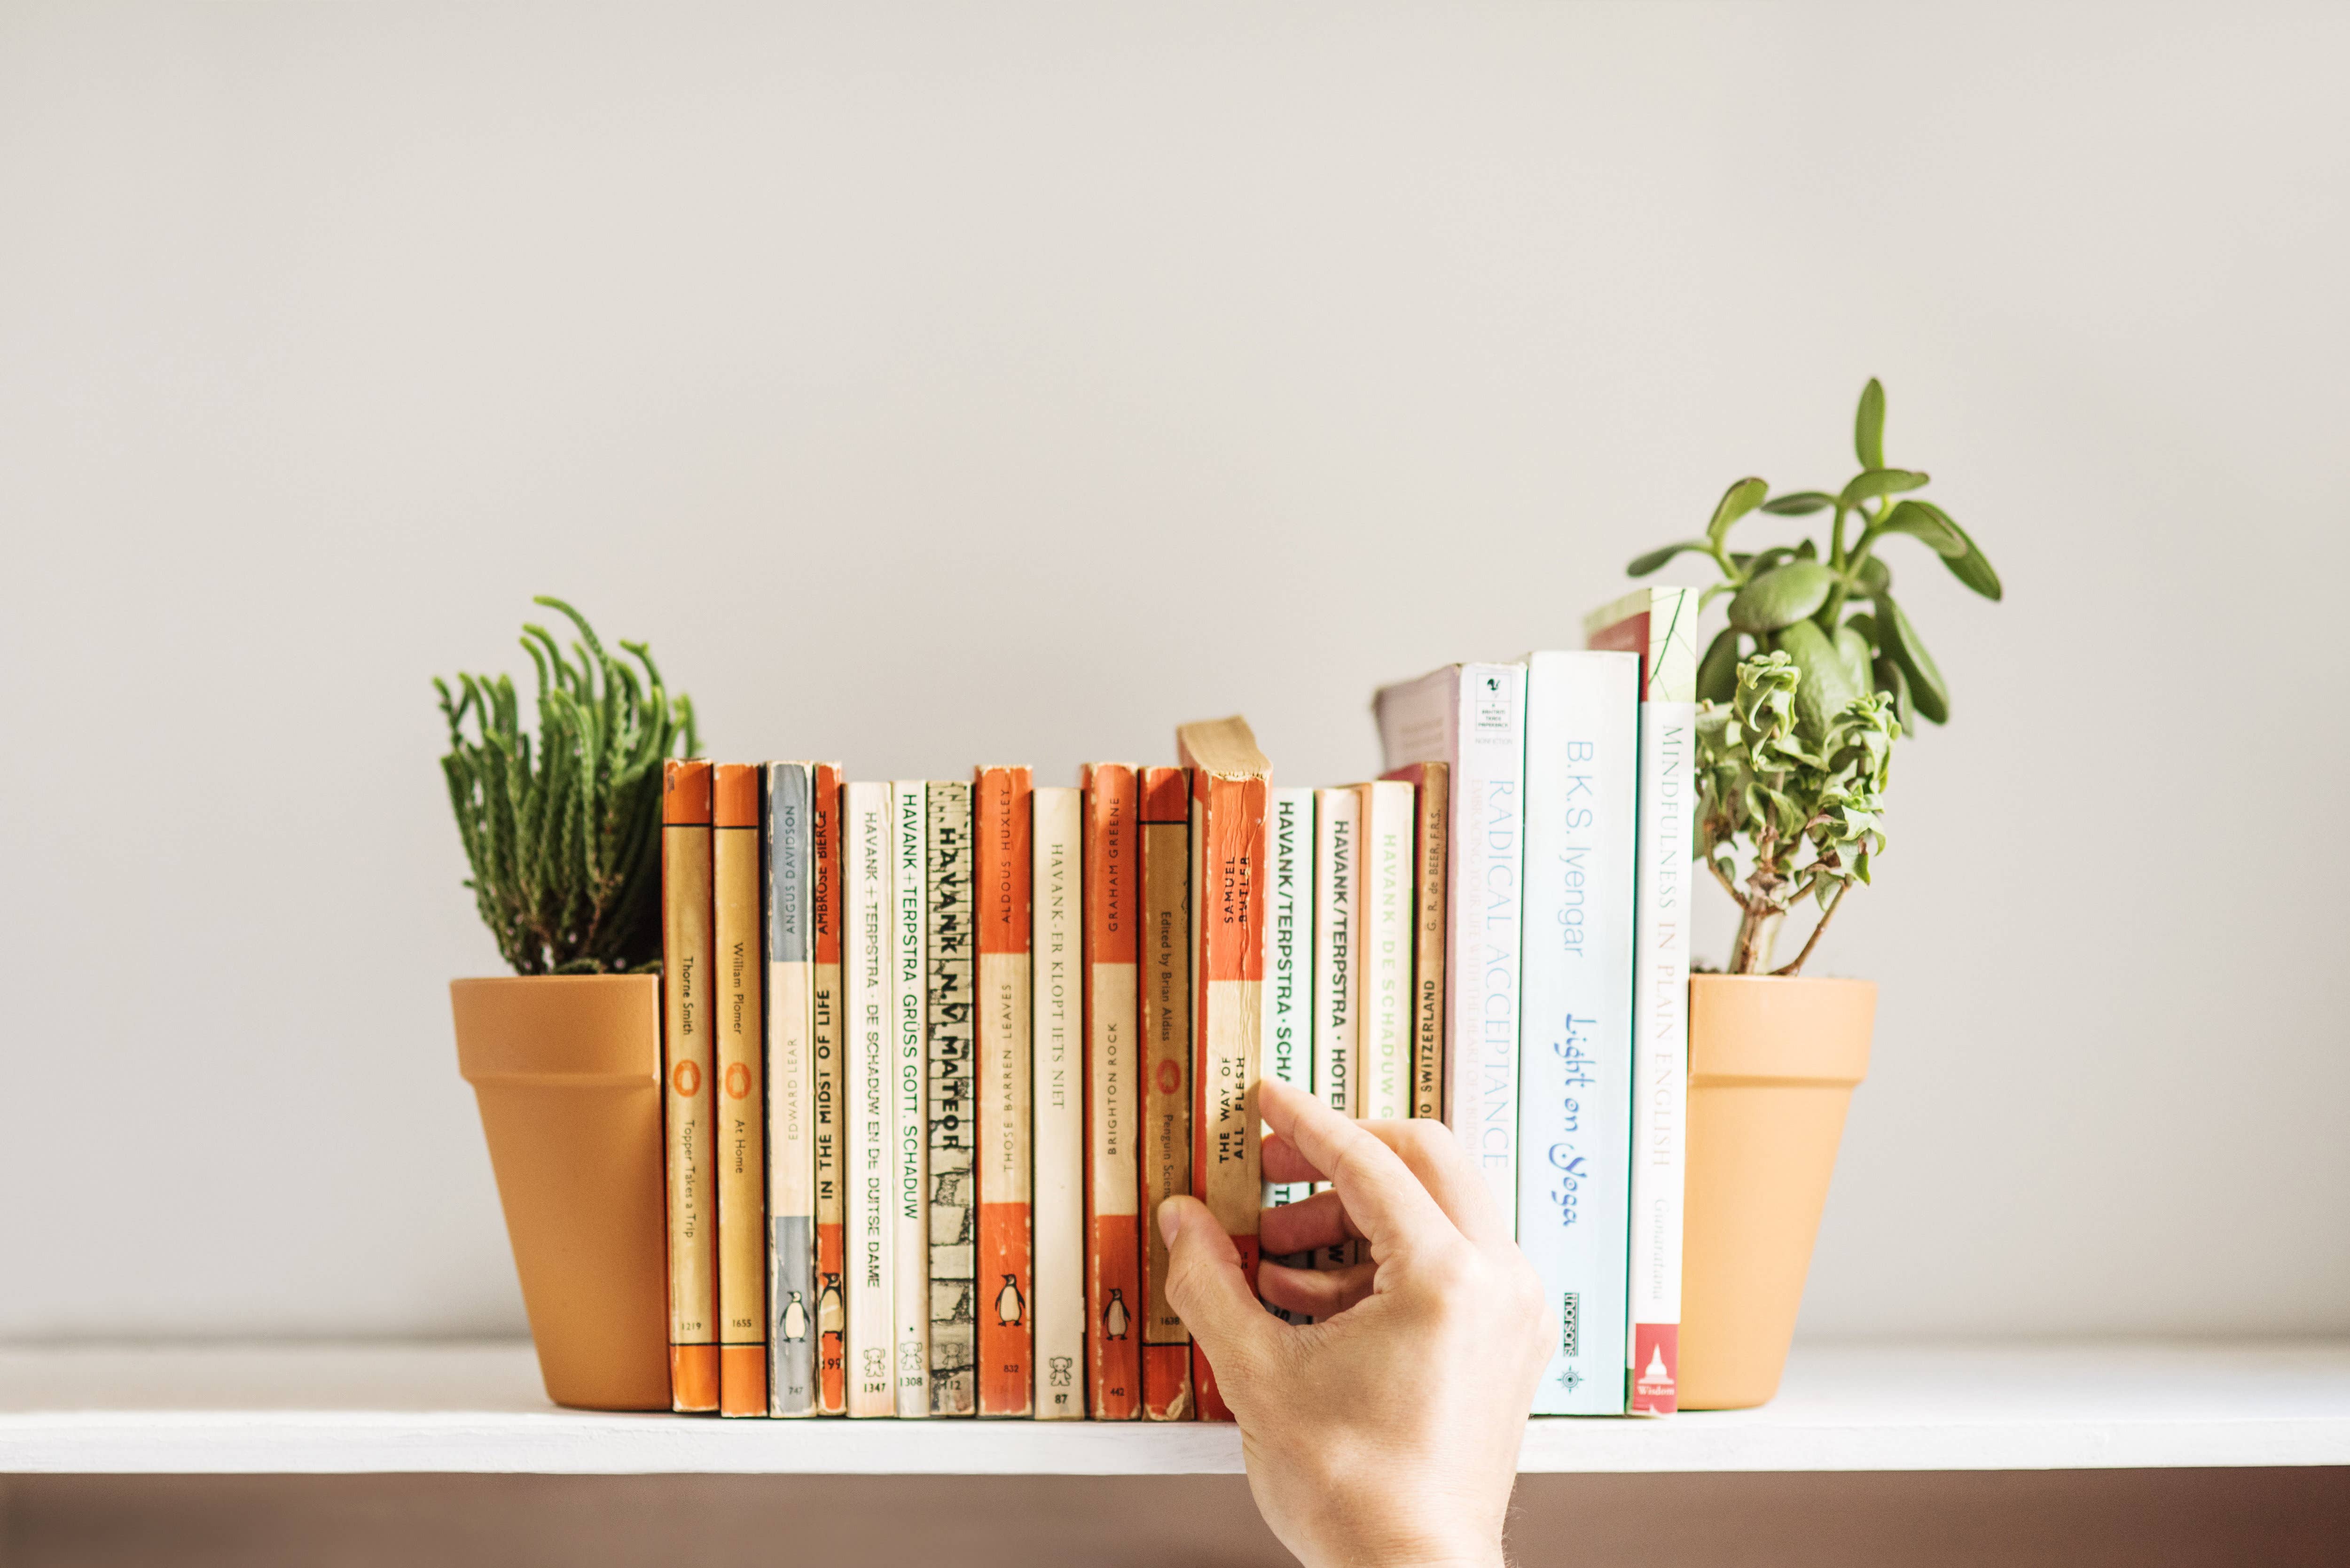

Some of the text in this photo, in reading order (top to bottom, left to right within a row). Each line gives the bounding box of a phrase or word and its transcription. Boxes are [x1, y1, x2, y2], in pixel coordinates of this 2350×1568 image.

[784, 806, 796, 934] ANGUS DAVIDSON
[817, 812, 828, 935] AMBROSE BIERCE
[865, 813, 877, 880] HAVANK
[999, 789, 1011, 924] ALDOUS HUXLEY
[1108, 798, 1119, 932] GRAHAM GREENE
[1383, 835, 1396, 922] HAVANK
[1428, 846, 1441, 874] BEER,
[1558, 741, 1593, 957] B.K.S. Iyengar
[1224, 856, 1235, 923] SAMUEL
[1238, 857, 1247, 923] BUTLER
[1277, 802, 1293, 1014] HAVANK/TERPSTRA
[1427, 901, 1437, 911] R.
[1428, 883, 1438, 894] de
[1469, 868, 1481, 907] YOUR
[866, 903, 878, 988] TERPSTRA
[1332, 821, 1349, 1027] HAVANK/TERPSTRA
[1382, 941, 1395, 969] DE
[1428, 922, 1436, 931] G.
[1653, 725, 1683, 1165] MINDFULNESS IN PLAIN ENGLISH
[682, 955, 694, 1034] Thorne Smith
[733, 941, 744, 1034] William Plomer
[940, 828, 960, 1151] HAVANK N.V. MATEOR
[1051, 962, 1064, 1019] KLOPT
[1158, 912, 1172, 1041] Edited by Brian Aldiss
[1467, 944, 1480, 982] WITH
[1483, 780, 1515, 1168] RADICAL ACCEPTANCE
[867, 1005, 878, 1025] DE
[903, 994, 920, 1057] GRÜSS
[1422, 981, 1435, 1092] SWITZERLAND
[1467, 988, 1480, 1018] THE
[1052, 1028, 1064, 1062] IETS
[1381, 979, 1396, 1096] SCHADUW
[787, 1038, 798, 1140] EDWARD LEAR
[817, 991, 833, 1199] IN THE MIDST OF LIFE
[867, 1032, 879, 1115] SCHADUW
[1002, 985, 1014, 1172] THOSE BARREN LEAVES
[1053, 1070, 1064, 1108] NIET
[1107, 1024, 1117, 1155] BRIGHTON ROCK
[682, 1121, 696, 1161] Topper
[868, 1122, 879, 1142] EN
[1161, 1115, 1174, 1159] Penguin
[1219, 1058, 1231, 1163] THE WAY OF
[1233, 1057, 1245, 1159] ALL FLESH
[1549, 1014, 1597, 1226] Light on Yoga
[735, 1120, 746, 1173] At Home
[868, 1148, 880, 1169] DE
[904, 1126, 917, 1219] SCHADUW
[685, 1165, 696, 1198] Takes
[868, 1178, 879, 1235] DUITSE
[683, 1213, 696, 1238] Trip
[1652, 1199, 1670, 1300] Gunaratana
[868, 1242, 879, 1287] DAME
[1564, 1293, 1576, 1356] thorsons
[864, 1383, 885, 1392] 1347
[901, 1377, 923, 1386] 1308
[1055, 1394, 1068, 1404] 87
[1638, 1386, 1674, 1396] Wisdom
